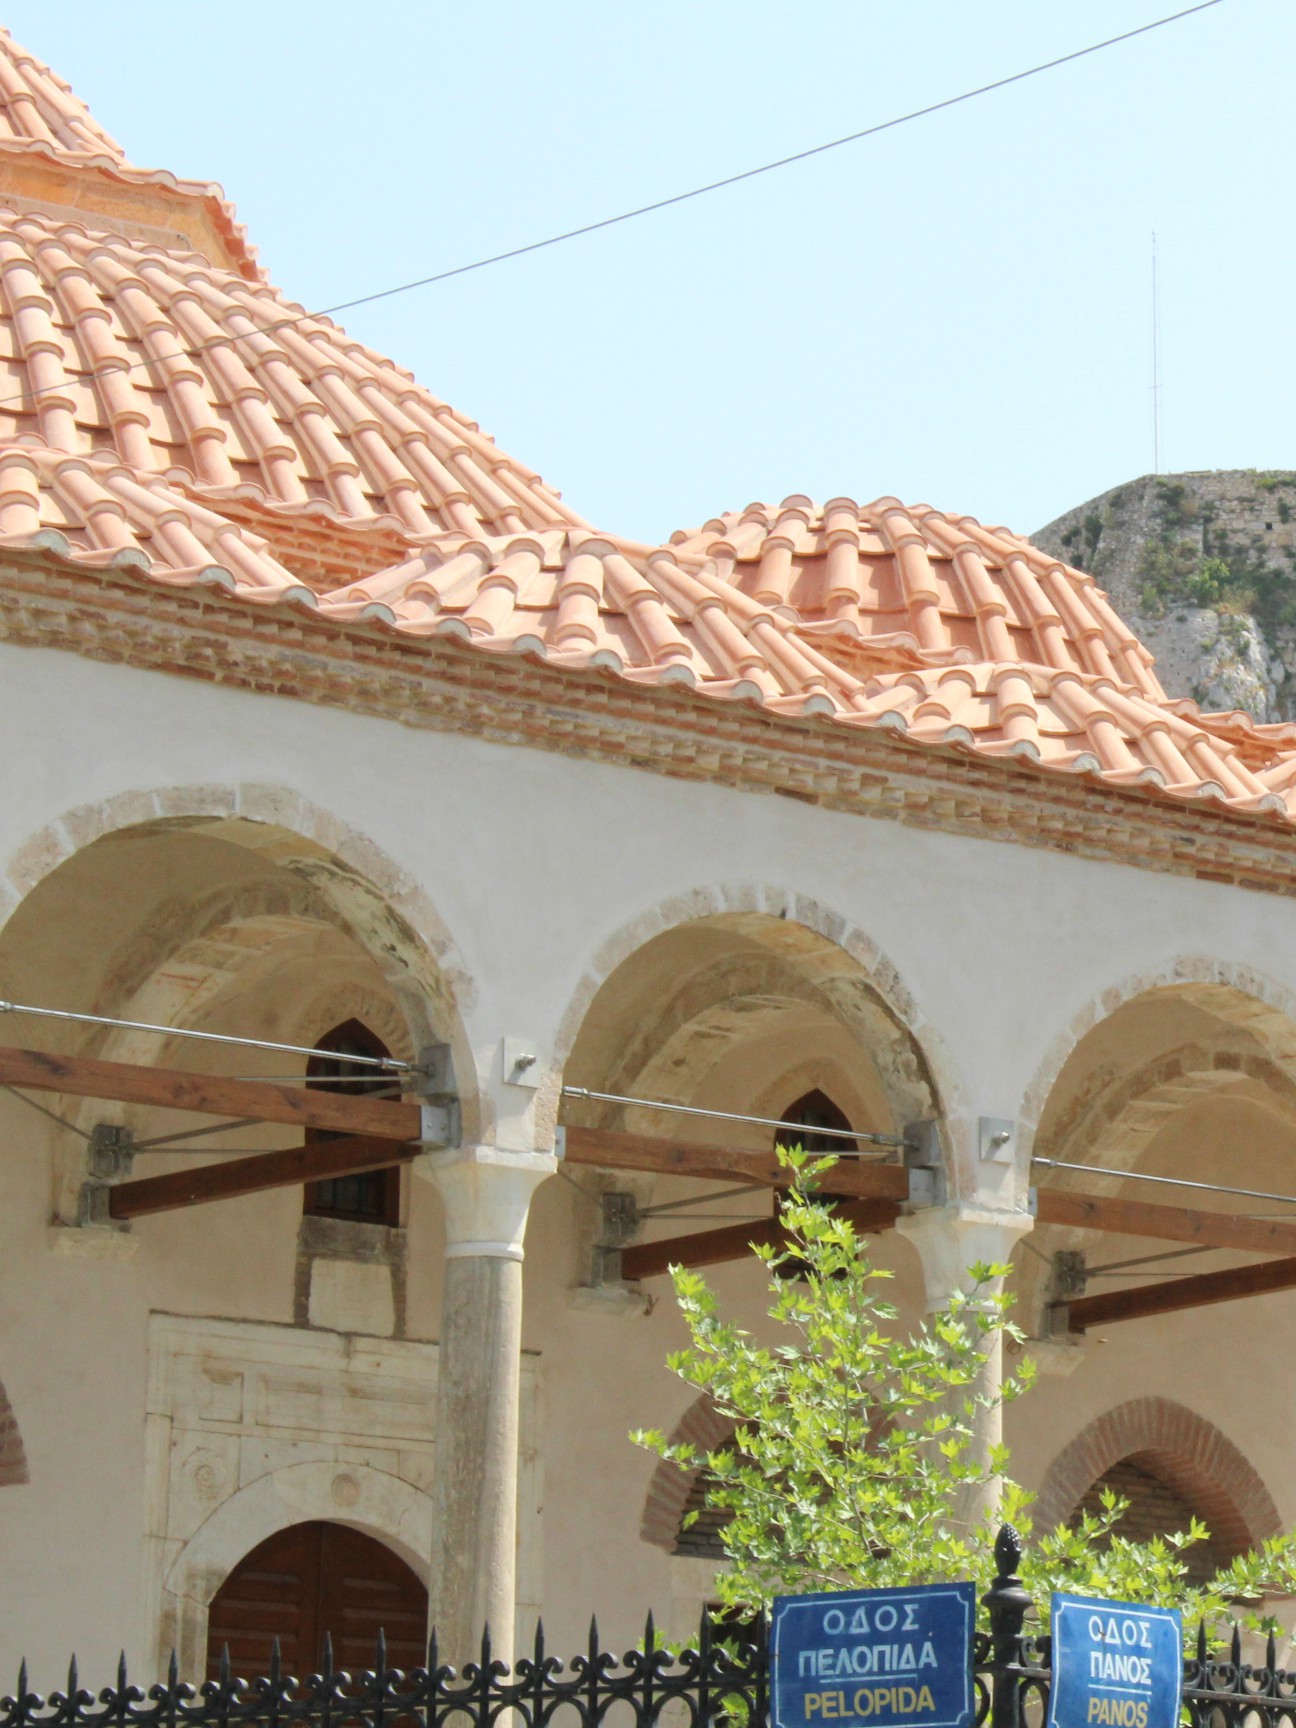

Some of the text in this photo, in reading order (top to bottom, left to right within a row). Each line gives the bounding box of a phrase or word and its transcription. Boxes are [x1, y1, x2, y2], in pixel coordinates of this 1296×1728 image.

[823, 1603, 920, 1635] ΟΔΟΣ
[1088, 1615, 1152, 1648] ΟΔΟΣ
[799, 1641, 938, 1678] ΠΕΛΟΠΙΔΑ
[1090, 1651, 1152, 1685] ΠΑΝΟΣ
[804, 1685, 936, 1720] PELOPIDA
[1087, 1697, 1149, 1728] PANOS
